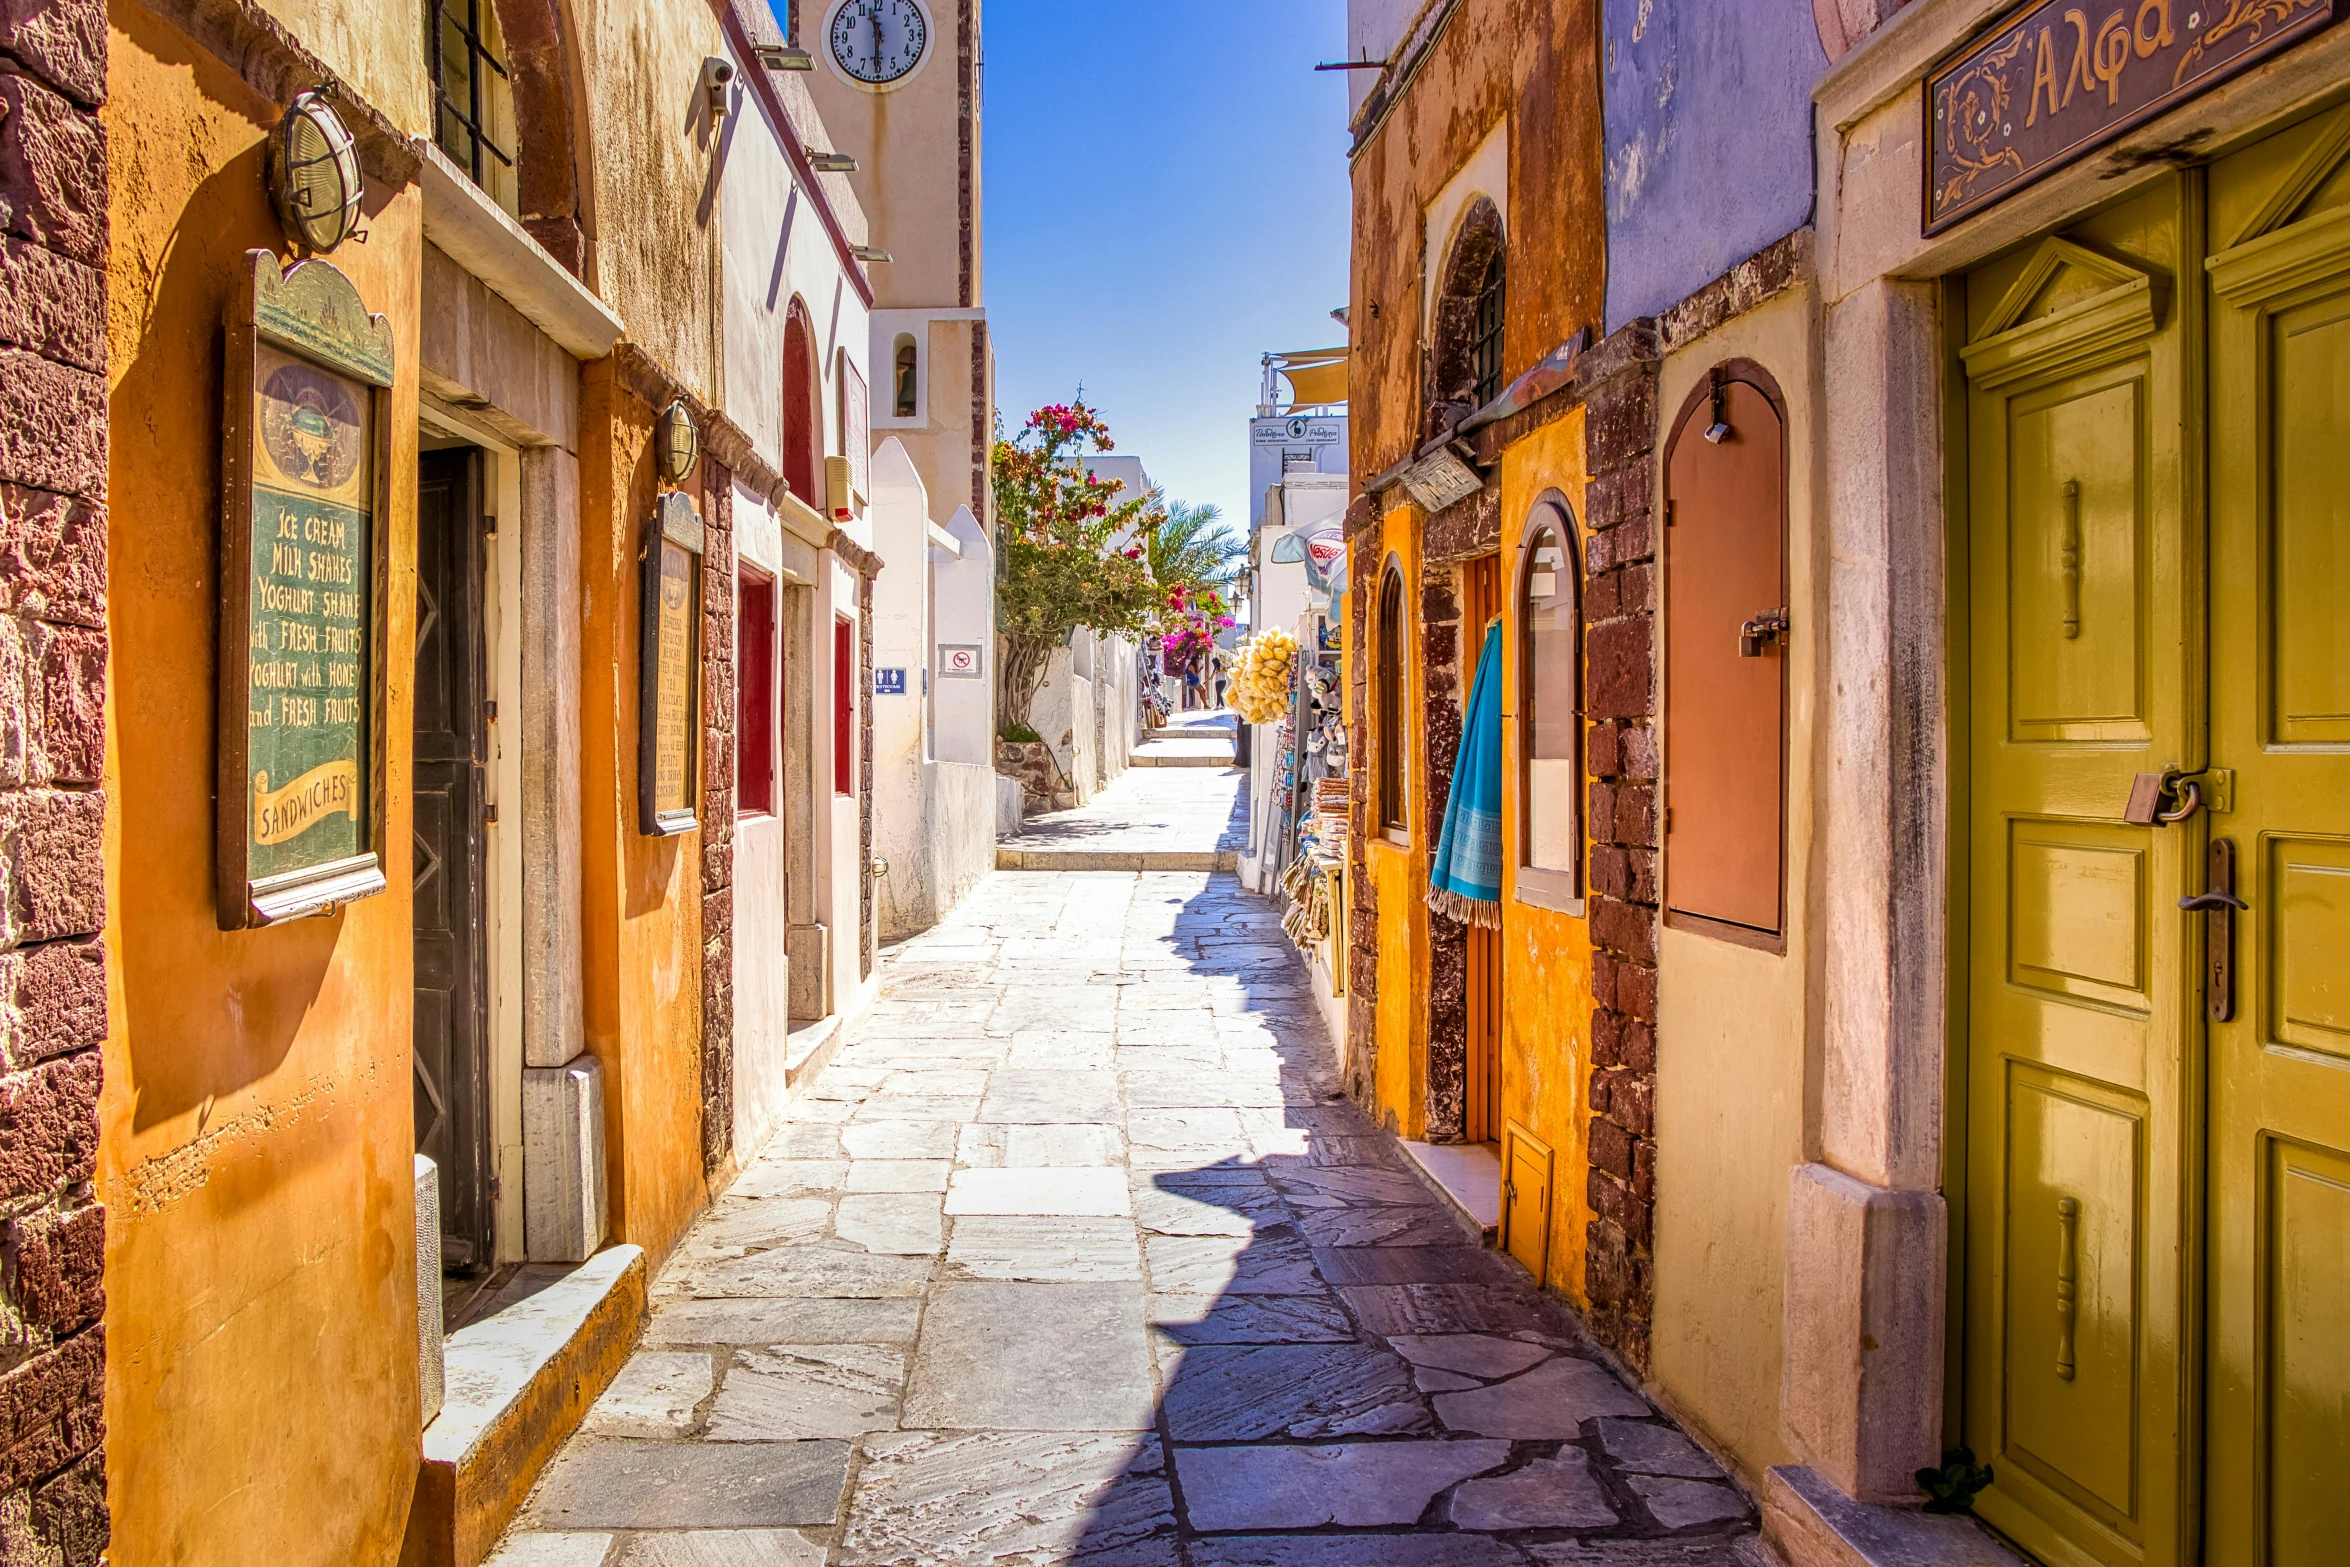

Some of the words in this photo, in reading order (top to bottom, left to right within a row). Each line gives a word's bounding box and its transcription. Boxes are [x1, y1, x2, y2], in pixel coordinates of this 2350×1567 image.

[858, 3, 866, 16] 11
[892, 2, 897, 15] 1
[846, 16, 856, 29] 10
[904, 14, 910, 27] 2
[842, 31, 848, 44] 9
[909, 29, 914, 42] 3
[847, 45, 853, 58] 8
[904, 43, 910, 56] 4
[860, 58, 866, 71] 7
[890, 57, 896, 69] 5
[276, 507, 298, 540] ICE
[304, 517, 346, 551] CREAM
[270, 541, 303, 579] MILK
[308, 551, 353, 585] SHAKES
[257, 575, 314, 615] YOGHURT
[322, 591, 360, 619] SHAKE
[280, 620, 318, 654] FRESH
[325, 626, 362, 655] FRUITS
[301, 661, 322, 688] with
[329, 662, 362, 690] HONEY
[249, 694, 272, 727] and
[281, 697, 318, 728] FRESH
[324, 697, 361, 724] FRUITS
[261, 774, 346, 839] SANDWICHES
